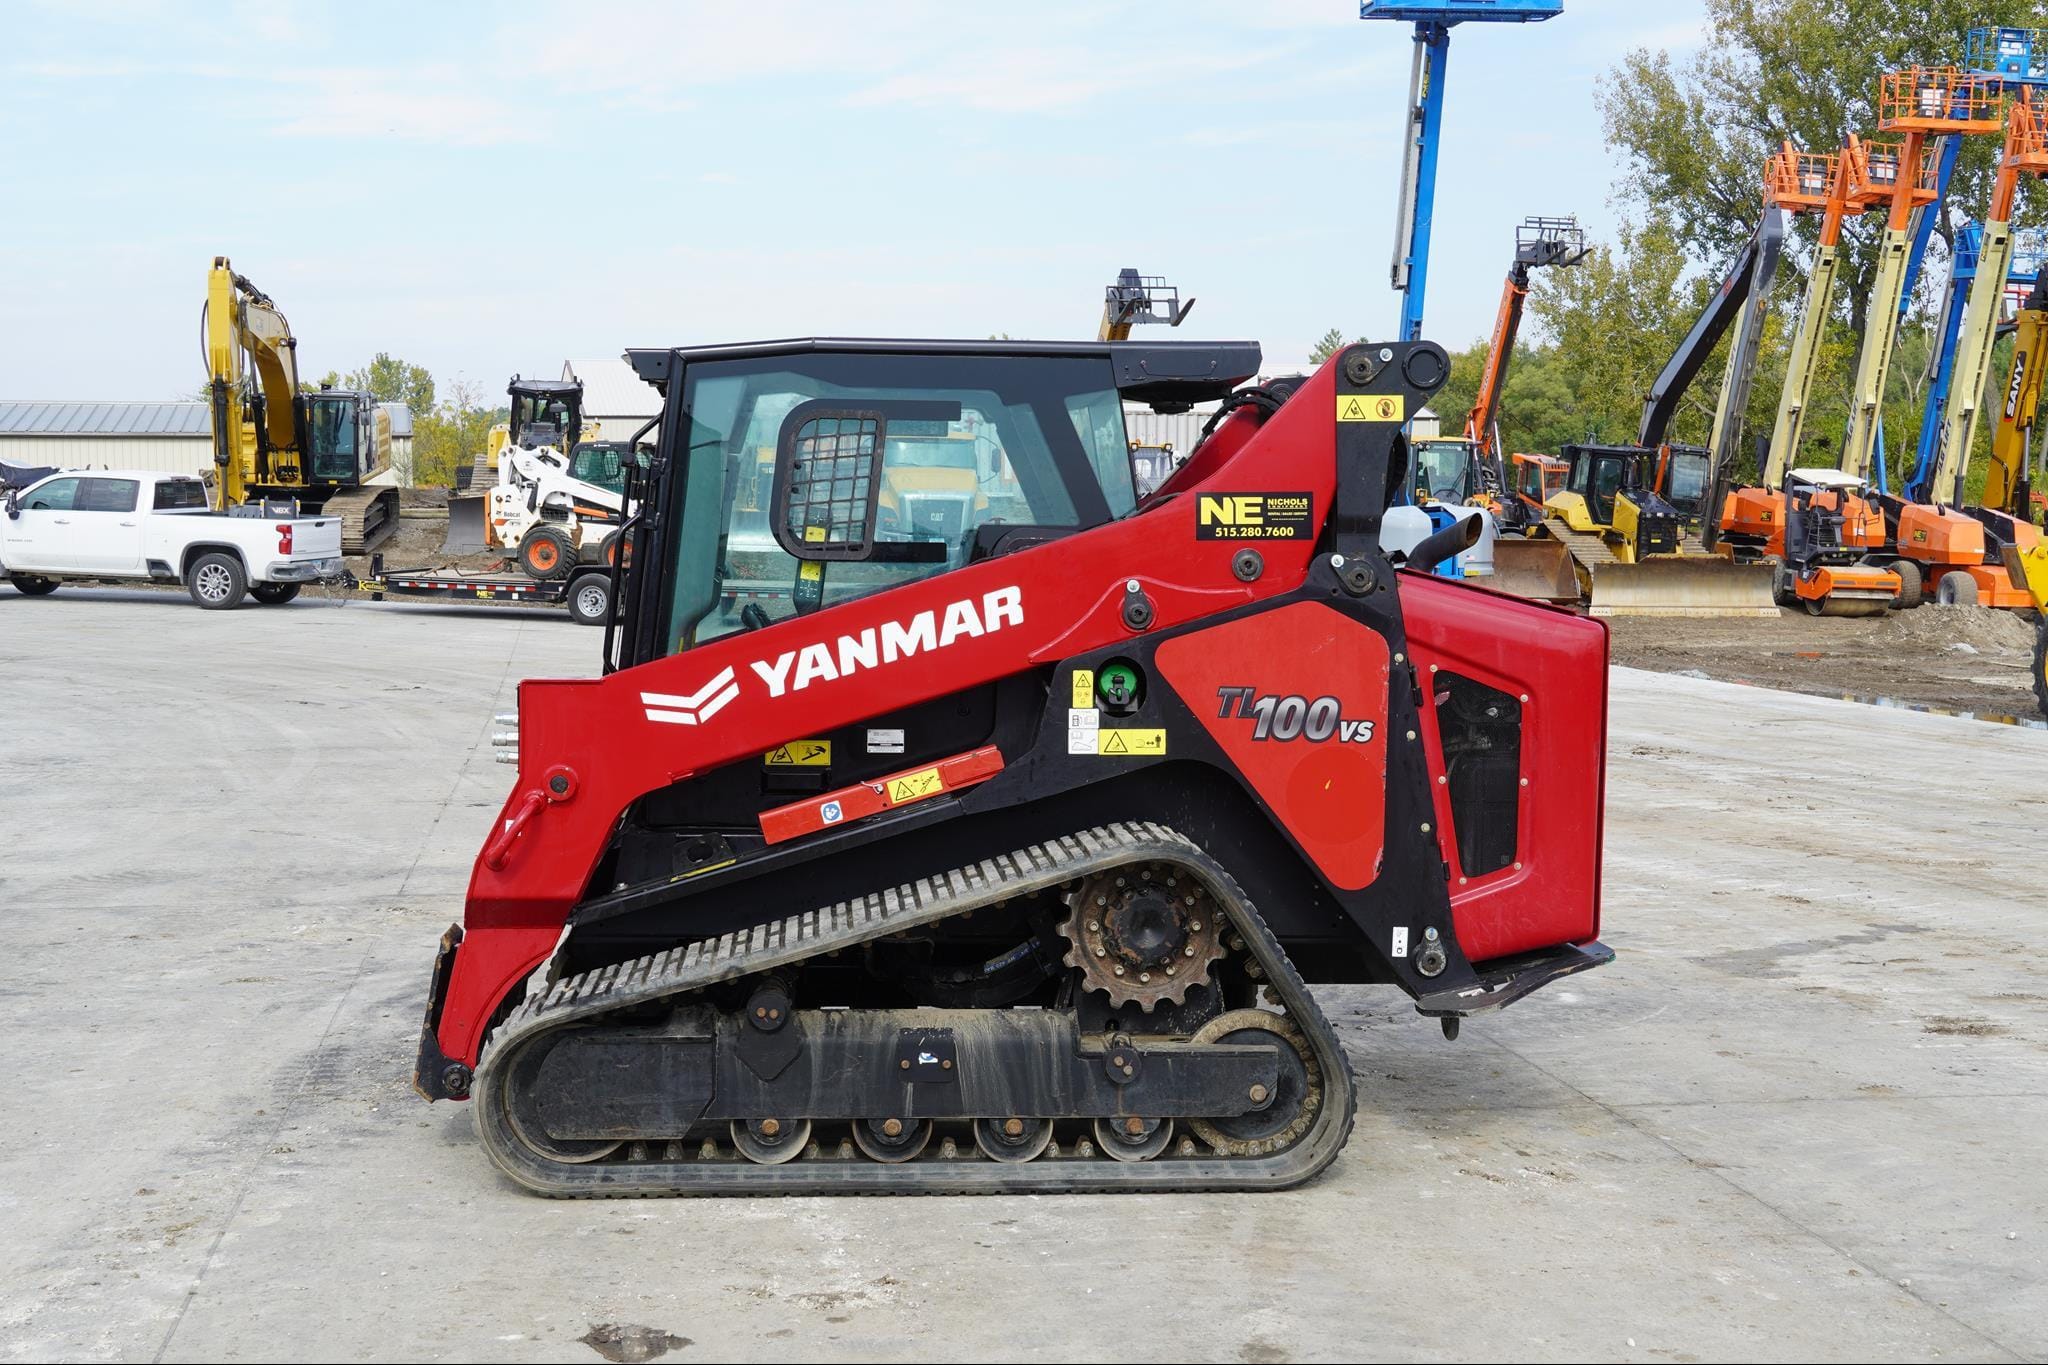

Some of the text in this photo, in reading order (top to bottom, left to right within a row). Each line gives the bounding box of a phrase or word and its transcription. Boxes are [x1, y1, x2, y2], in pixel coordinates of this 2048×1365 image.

[2006, 359, 2023, 417] SANY
[1201, 497, 1263, 525] NE
[1267, 498, 1308, 506] NICHOLS
[930, 512, 944, 521] CAT
[1215, 527, 1295, 538] 515.280.7600
[750, 586, 1024, 697] YANMAR
